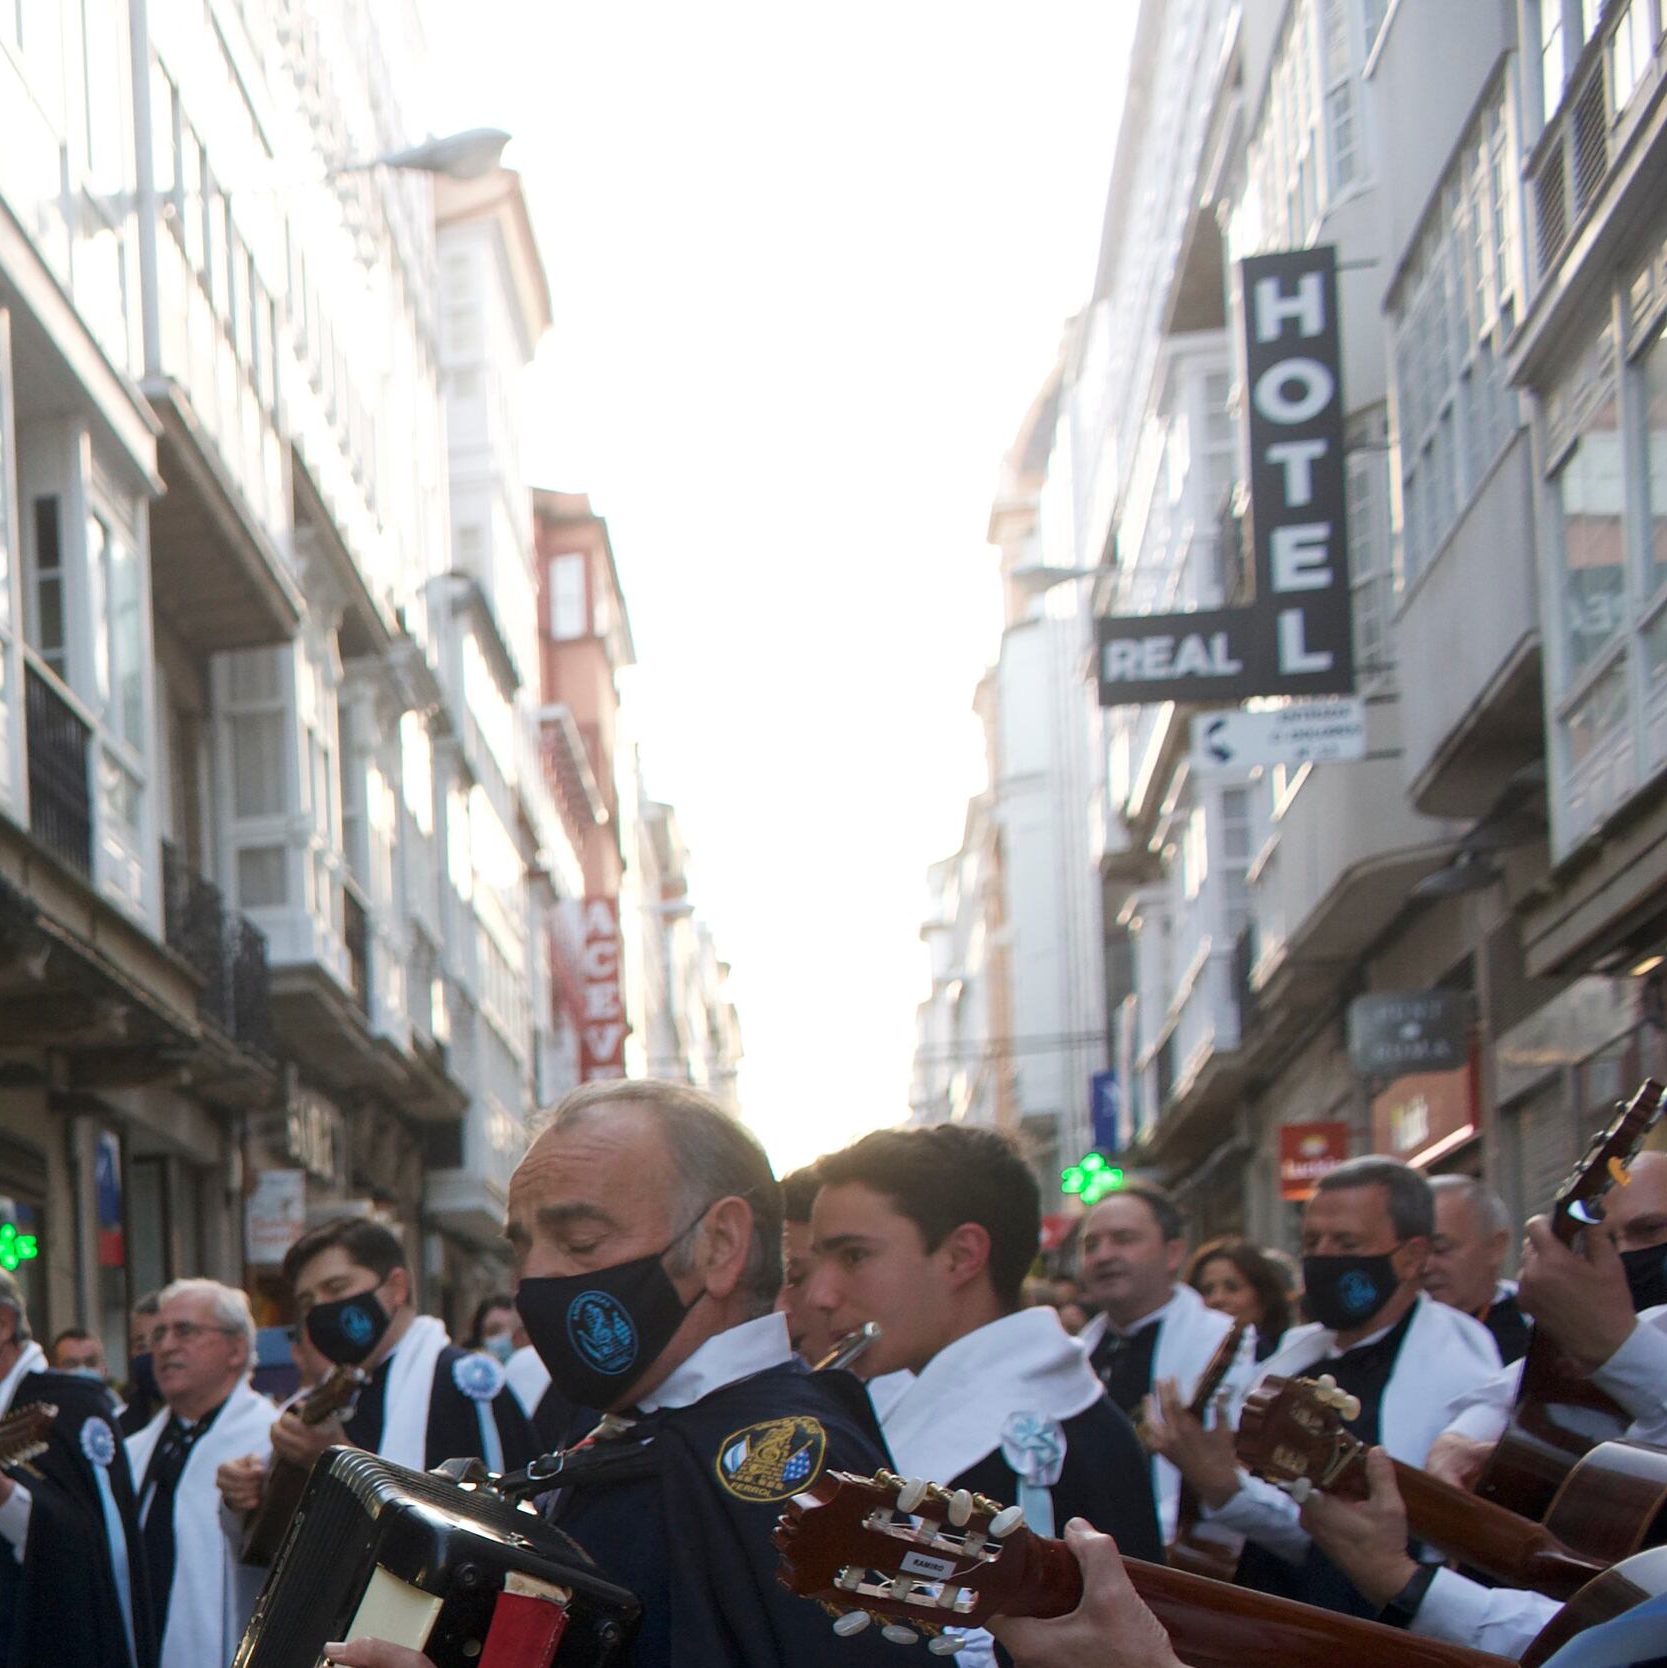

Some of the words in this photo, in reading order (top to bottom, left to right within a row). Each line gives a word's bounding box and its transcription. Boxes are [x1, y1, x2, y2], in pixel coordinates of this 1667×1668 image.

[1253, 271, 1335, 675] HOTEL
[1104, 631, 1244, 684] REAL
[584, 900, 622, 1081] ACEV
